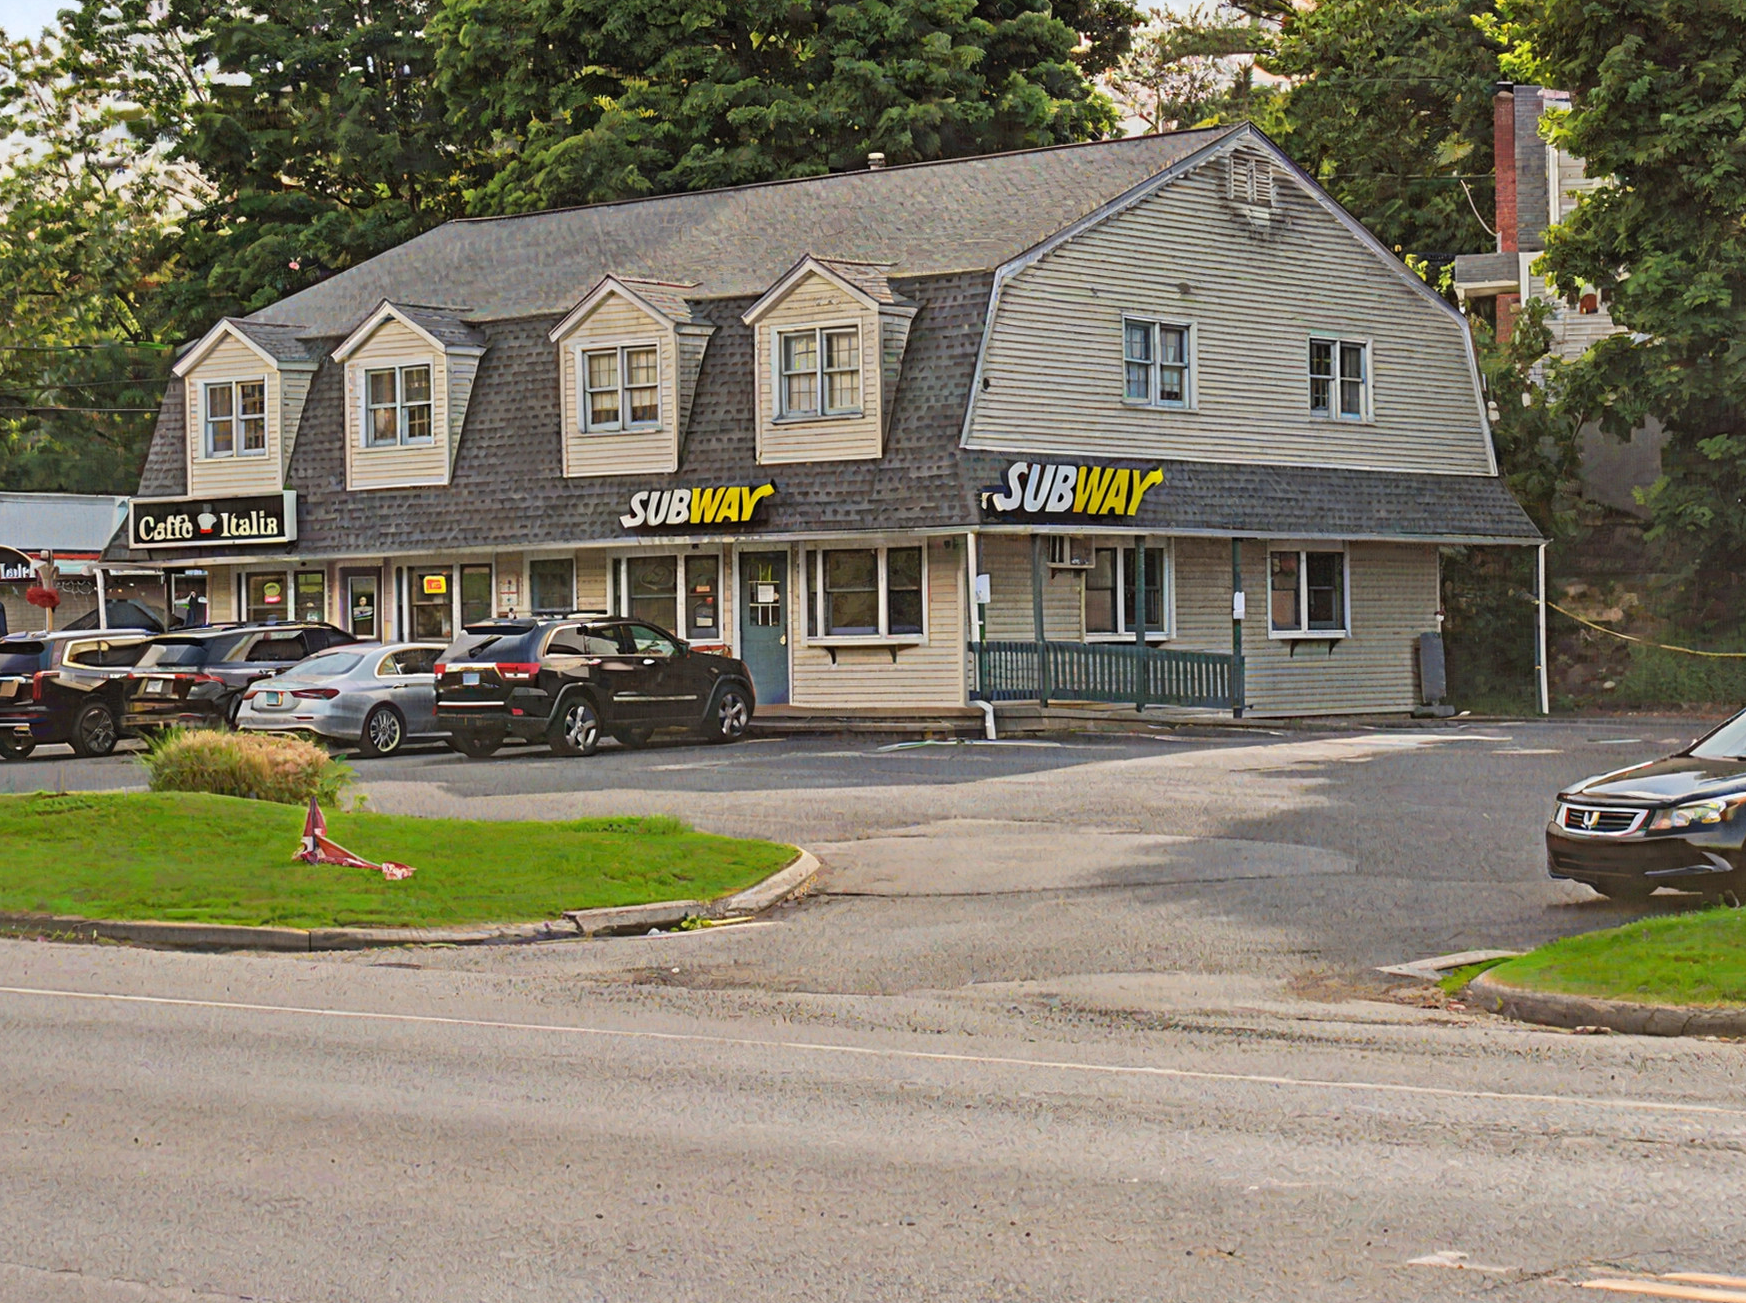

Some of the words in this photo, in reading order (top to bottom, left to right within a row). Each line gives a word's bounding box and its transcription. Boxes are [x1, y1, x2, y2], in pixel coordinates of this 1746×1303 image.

[619, 483, 776, 529] SUBWAY
[992, 461, 1164, 516] SUBWAY
[219, 509, 278, 537] Italia
